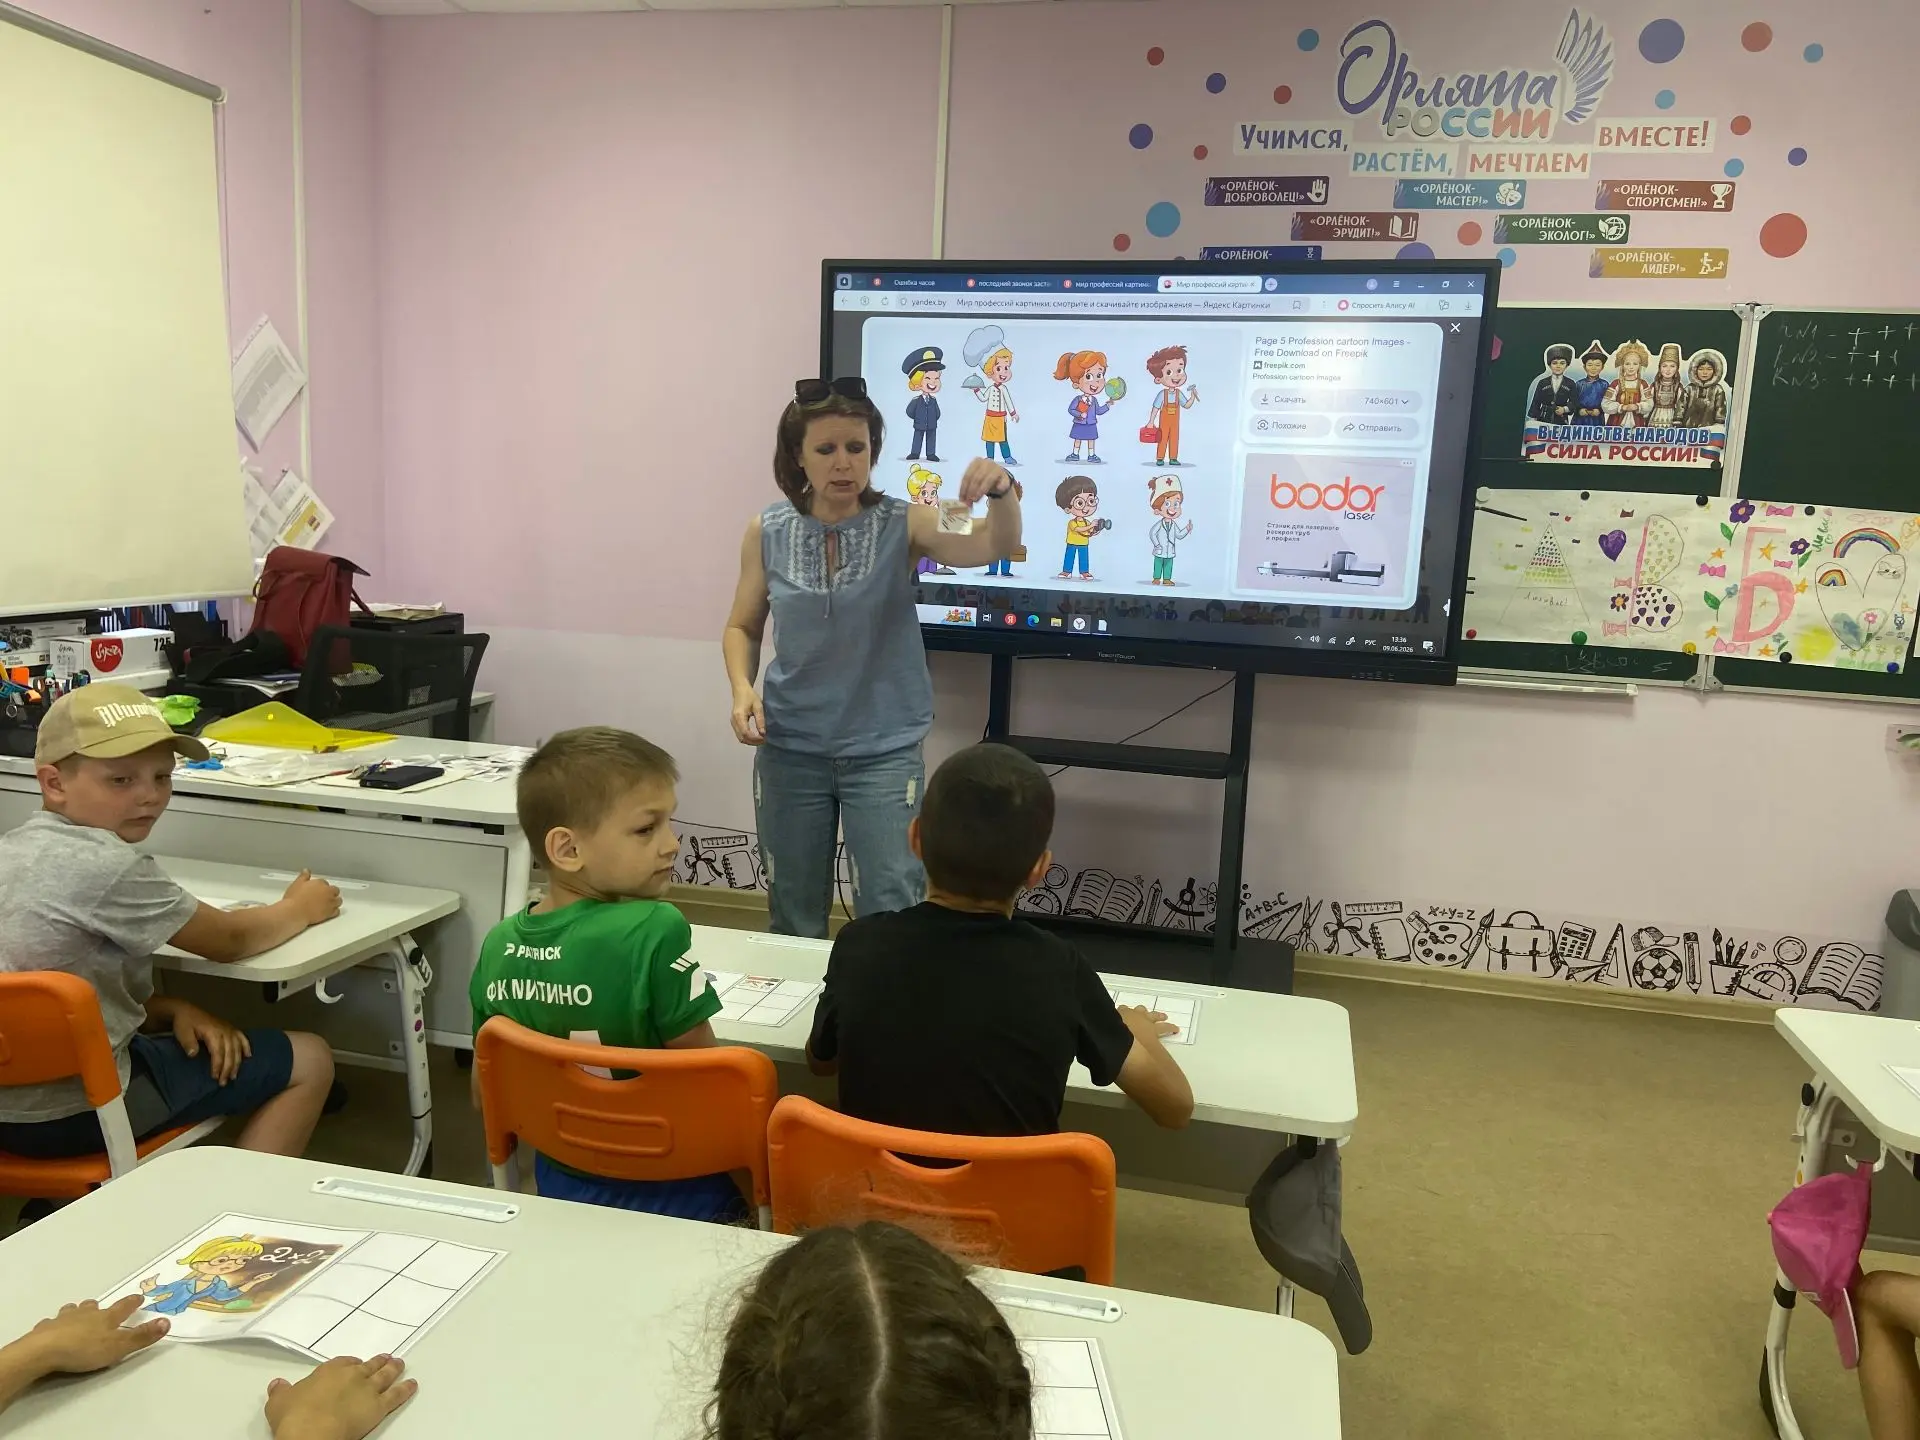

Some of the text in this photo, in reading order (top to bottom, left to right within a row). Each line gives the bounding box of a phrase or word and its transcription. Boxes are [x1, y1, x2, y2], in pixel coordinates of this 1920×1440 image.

[1338, 19, 1557, 125] Орлята
[1386, 106, 1551, 138] РОССИИ
[1599, 120, 1709, 147] ВМЕСТЕ!
[1352, 148, 1589, 176] РАСТЁМ, МЕЧТАЕМ
[911, 298, 947, 308] yandex.by
[956, 298, 974, 308] Мир
[974, 298, 1014, 309] профессий
[1052, 301, 1089, 309] смотрите
[1096, 301, 1140, 309] скачивайте
[1140, 301, 1193, 310] изображения
[1202, 301, 1231, 310] Яндекс
[1232, 302, 1271, 311] Картинки
[1351, 301, 1385, 310] Спросить
[1385, 302, 1407, 311] Алису
[1255, 336, 1278, 347] Page
[1280, 337, 1286, 345] 5
[1288, 336, 1334, 346] Profession
[1336, 337, 1370, 346] cartoon
[1371, 337, 1405, 348] Images
[1254, 348, 1369, 359] Free Download on Freepik
[1263, 360, 1306, 370] freepik.com
[1274, 395, 1307, 404] Скачать
[1271, 421, 1307, 431] Похожие
[1358, 423, 1403, 433] Отправить
[1537, 425, 1710, 446] В ЕДИНСТВЕ НАРОДОВ
[1546, 443, 1699, 463] СИЛА РОССИИ!
[1270, 473, 1385, 513] bodor
[1343, 510, 1376, 520] laser
[1364, 639, 1377, 647] РУС
[1382, 645, 1414, 653] 09.06.2026
[516, 943, 562, 961] PATRICK
[486, 978, 509, 1003] ФК
